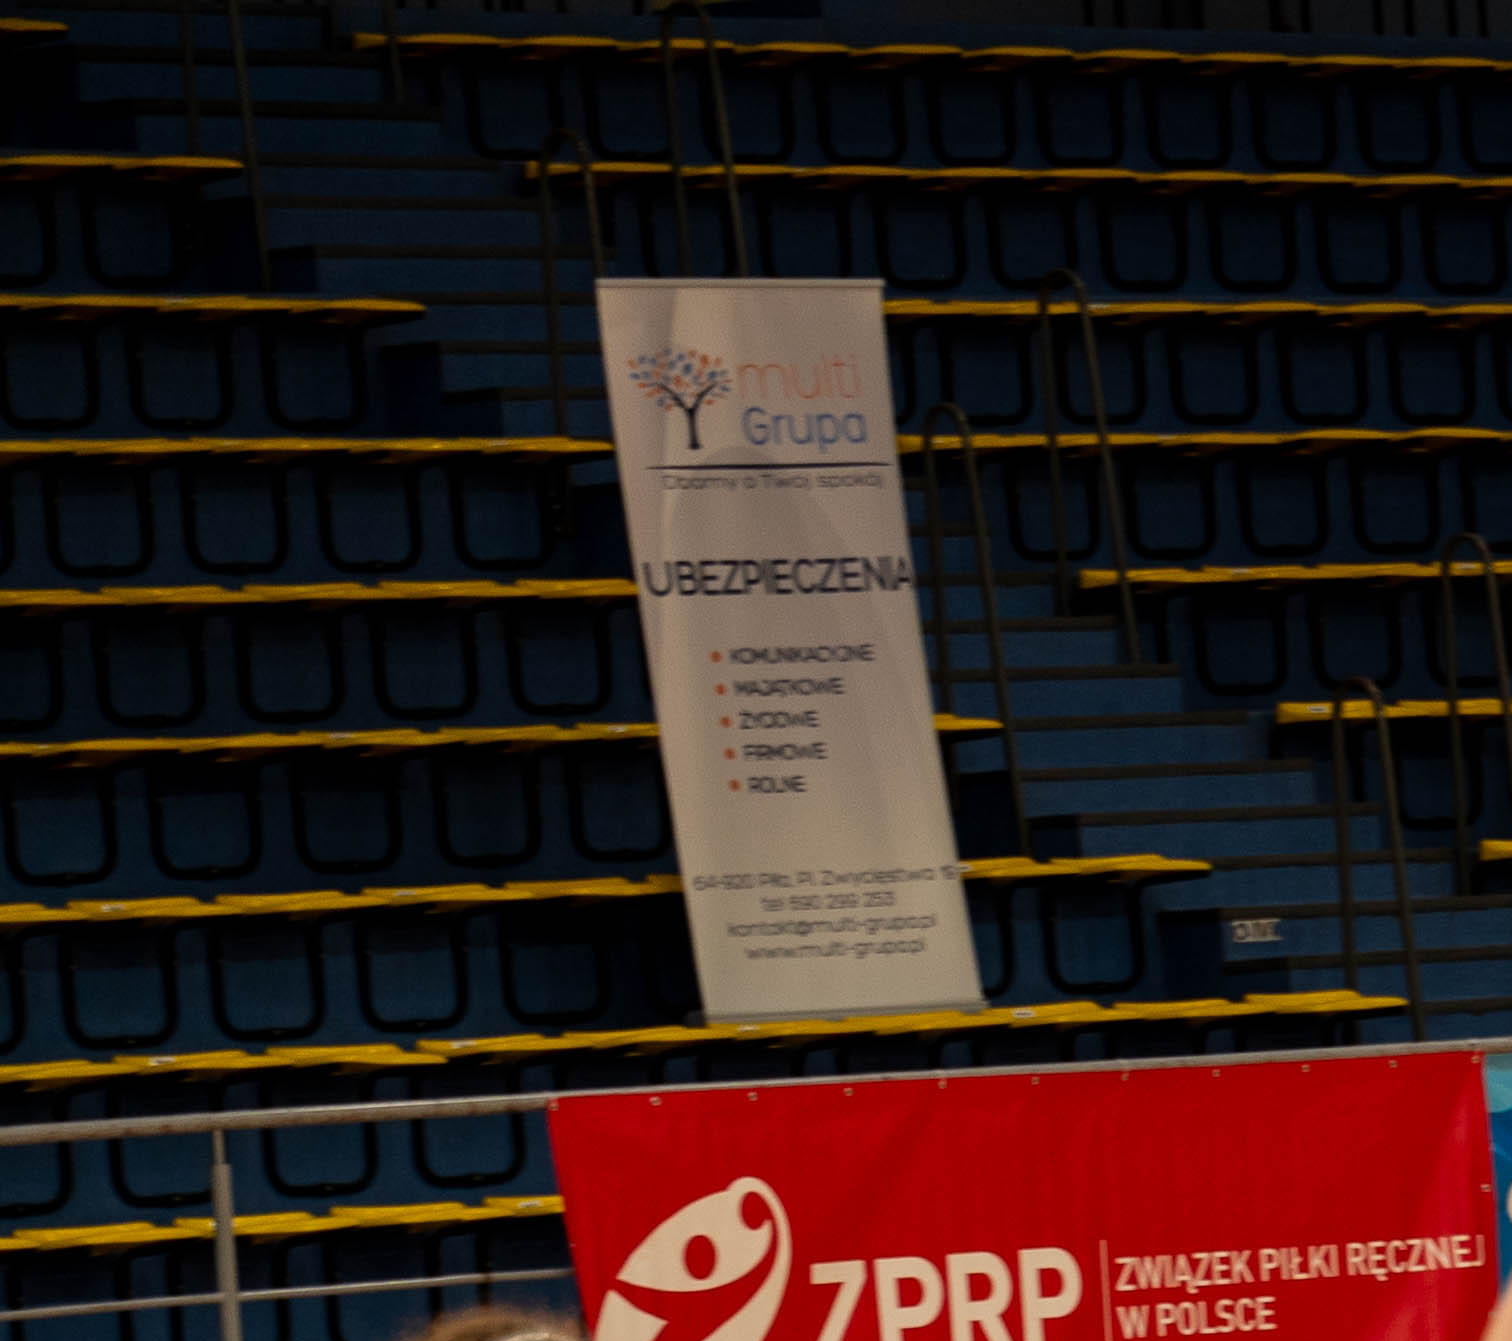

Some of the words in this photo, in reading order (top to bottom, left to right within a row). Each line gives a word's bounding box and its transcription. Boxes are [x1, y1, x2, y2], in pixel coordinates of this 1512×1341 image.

[736, 354, 864, 400] multi
[742, 405, 868, 453] Grupa
[642, 556, 911, 597] UBEZPIECZENIA
[747, 775, 807, 794] ROLNE
[1114, 1250, 1255, 1294] ZWIĄZEK
[1258, 1244, 1340, 1282] PIŁKI
[1346, 1234, 1486, 1282] RĘCZNEJ
[1115, 1304, 1150, 1340] W
[1155, 1296, 1278, 1338] POLSCE
